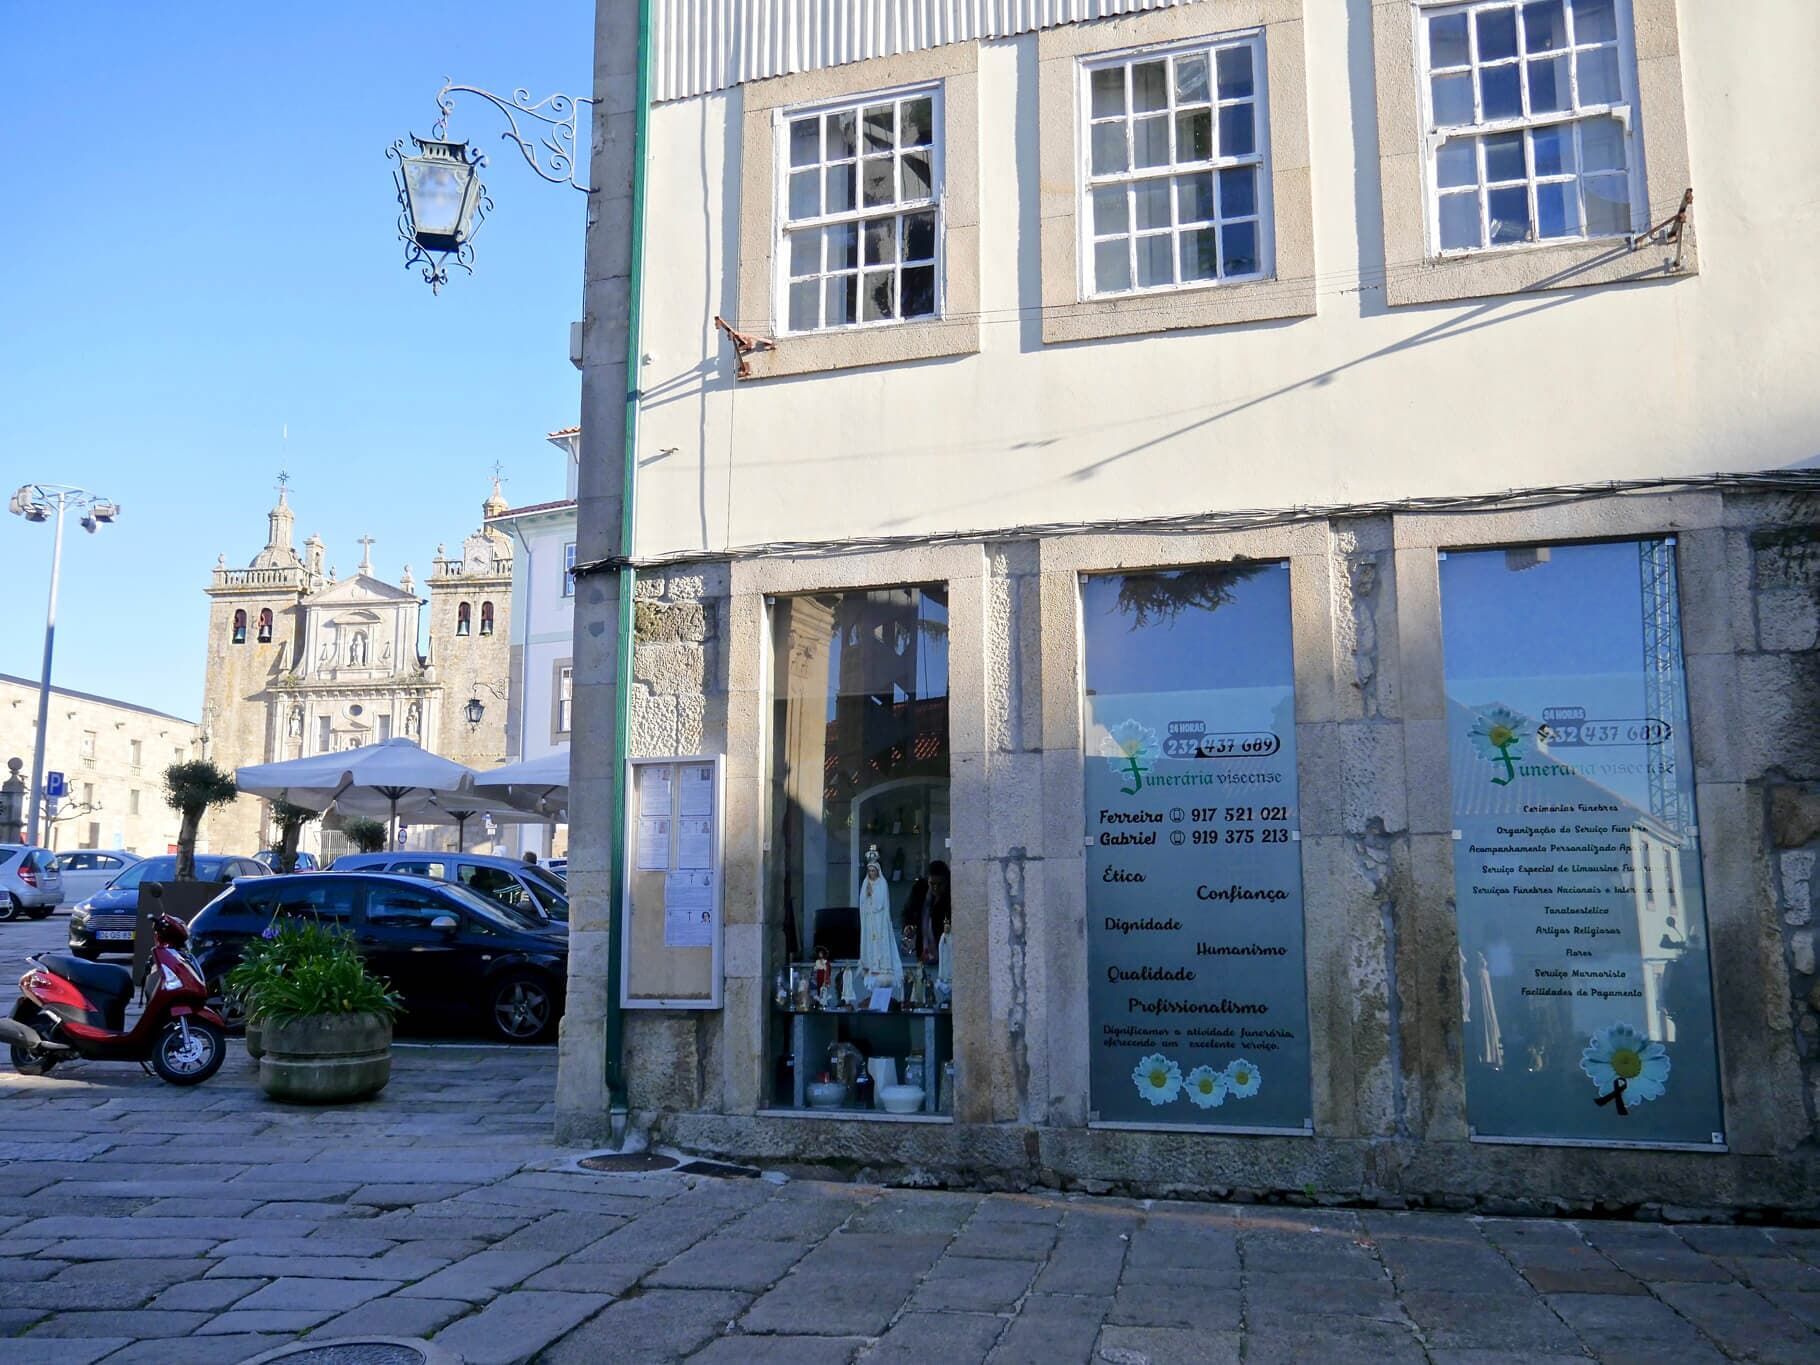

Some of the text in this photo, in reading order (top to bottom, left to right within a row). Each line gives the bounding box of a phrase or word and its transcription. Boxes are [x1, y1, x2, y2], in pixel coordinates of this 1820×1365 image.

[1556, 709, 1584, 720] HORAS
[1169, 723, 1204, 733] 24 HORAS
[1585, 726, 1618, 740] 437
[1168, 738, 1272, 754] 232 437 689
[50, 773, 61, 793] P
[1100, 807, 1288, 825] Ferreira 917 521 021
[1574, 825, 1608, 835] Serviço
[1100, 829, 1288, 846] Gabriel 919 375 213
[1468, 844, 1546, 855] Acompanhamento
[1550, 844, 1616, 855] Personalizado
[1103, 865, 1146, 883] Ética
[1482, 865, 1514, 876] Serviço
[1518, 864, 1554, 876] Especial
[1557, 864, 1568, 872] de
[1572, 864, 1618, 872] Limousine
[1196, 885, 1289, 903] Confiança
[1472, 886, 1510, 896] Serviços
[1556, 886, 1602, 894] Nacionais
[1105, 917, 1182, 934] Dignidade
[1536, 926, 1622, 938] Artigos Religiosos
[1196, 943, 1287, 956] Humanismo
[1566, 949, 1592, 957] Flores
[1107, 966, 1196, 983] Qualidade
[1535, 969, 1568, 979] Serviço
[1521, 987, 1642, 1000] Facilidades de Pagamento
[1128, 998, 1268, 1016] Profissionalismo
[1104, 1025, 1168, 1038] Dignificamos
[1186, 1026, 1235, 1037] atividade
[1104, 1038, 1156, 1048] oferecendo
[1162, 1040, 1178, 1048] um
[1189, 1038, 1236, 1048] excelente
